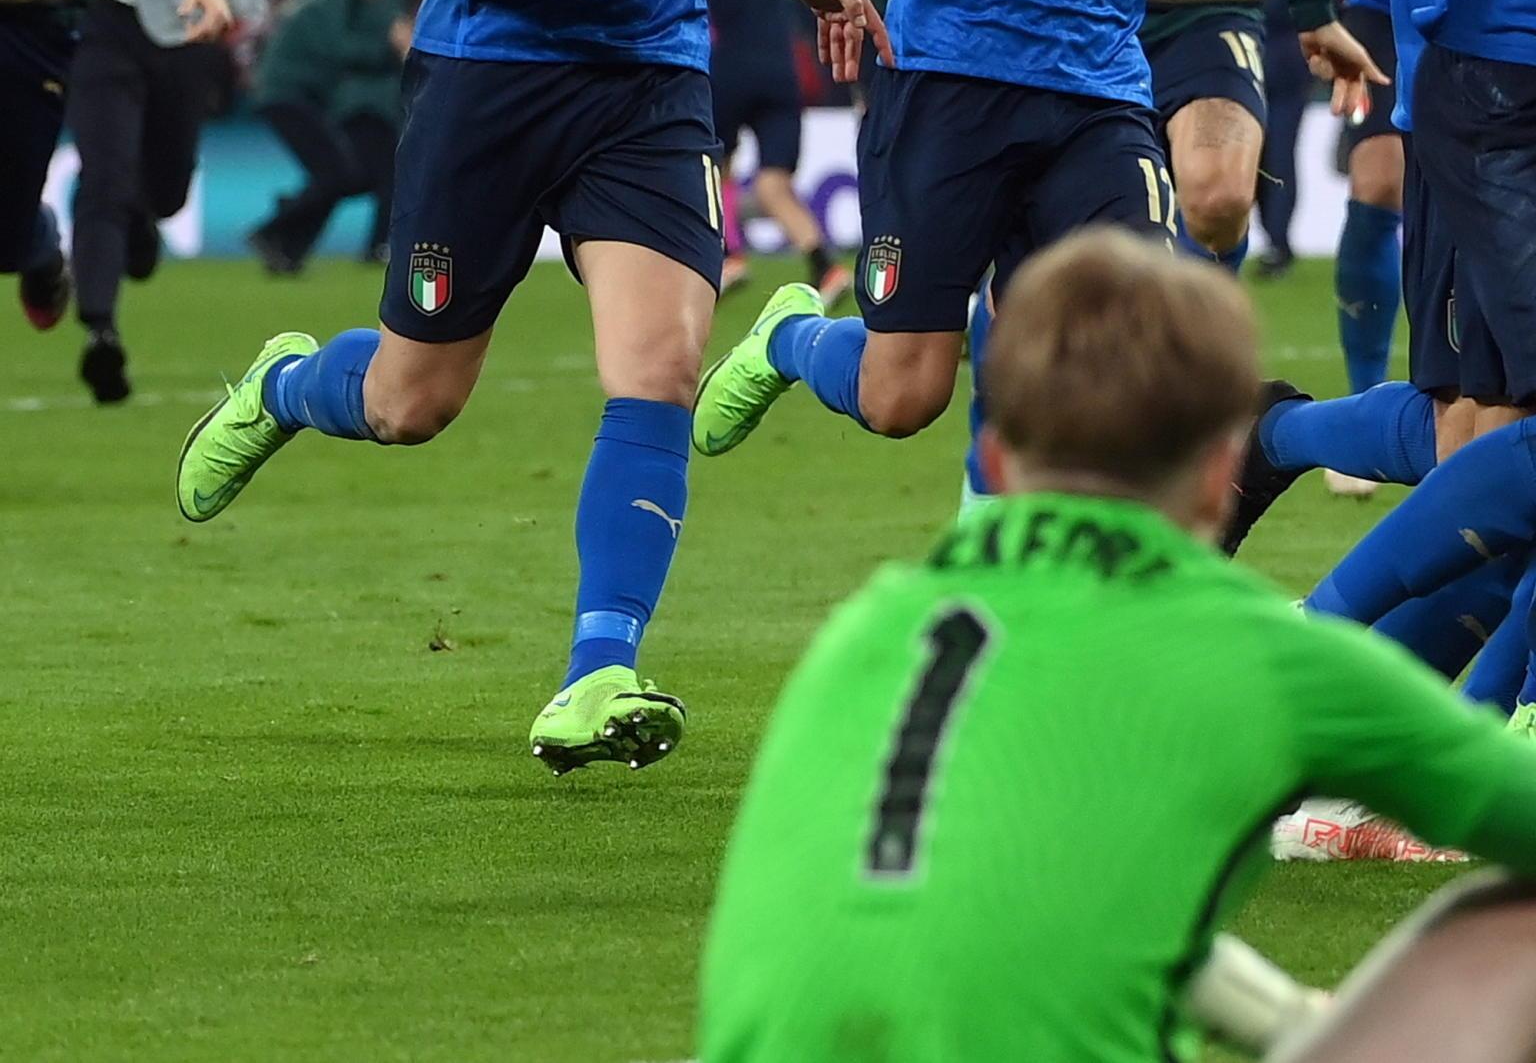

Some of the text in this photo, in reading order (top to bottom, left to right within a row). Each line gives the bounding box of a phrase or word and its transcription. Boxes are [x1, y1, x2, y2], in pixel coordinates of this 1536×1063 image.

[871, 248, 898, 261] ITALIA
[413, 257, 448, 270] ITALIA
[864, 601, 994, 879] 1
